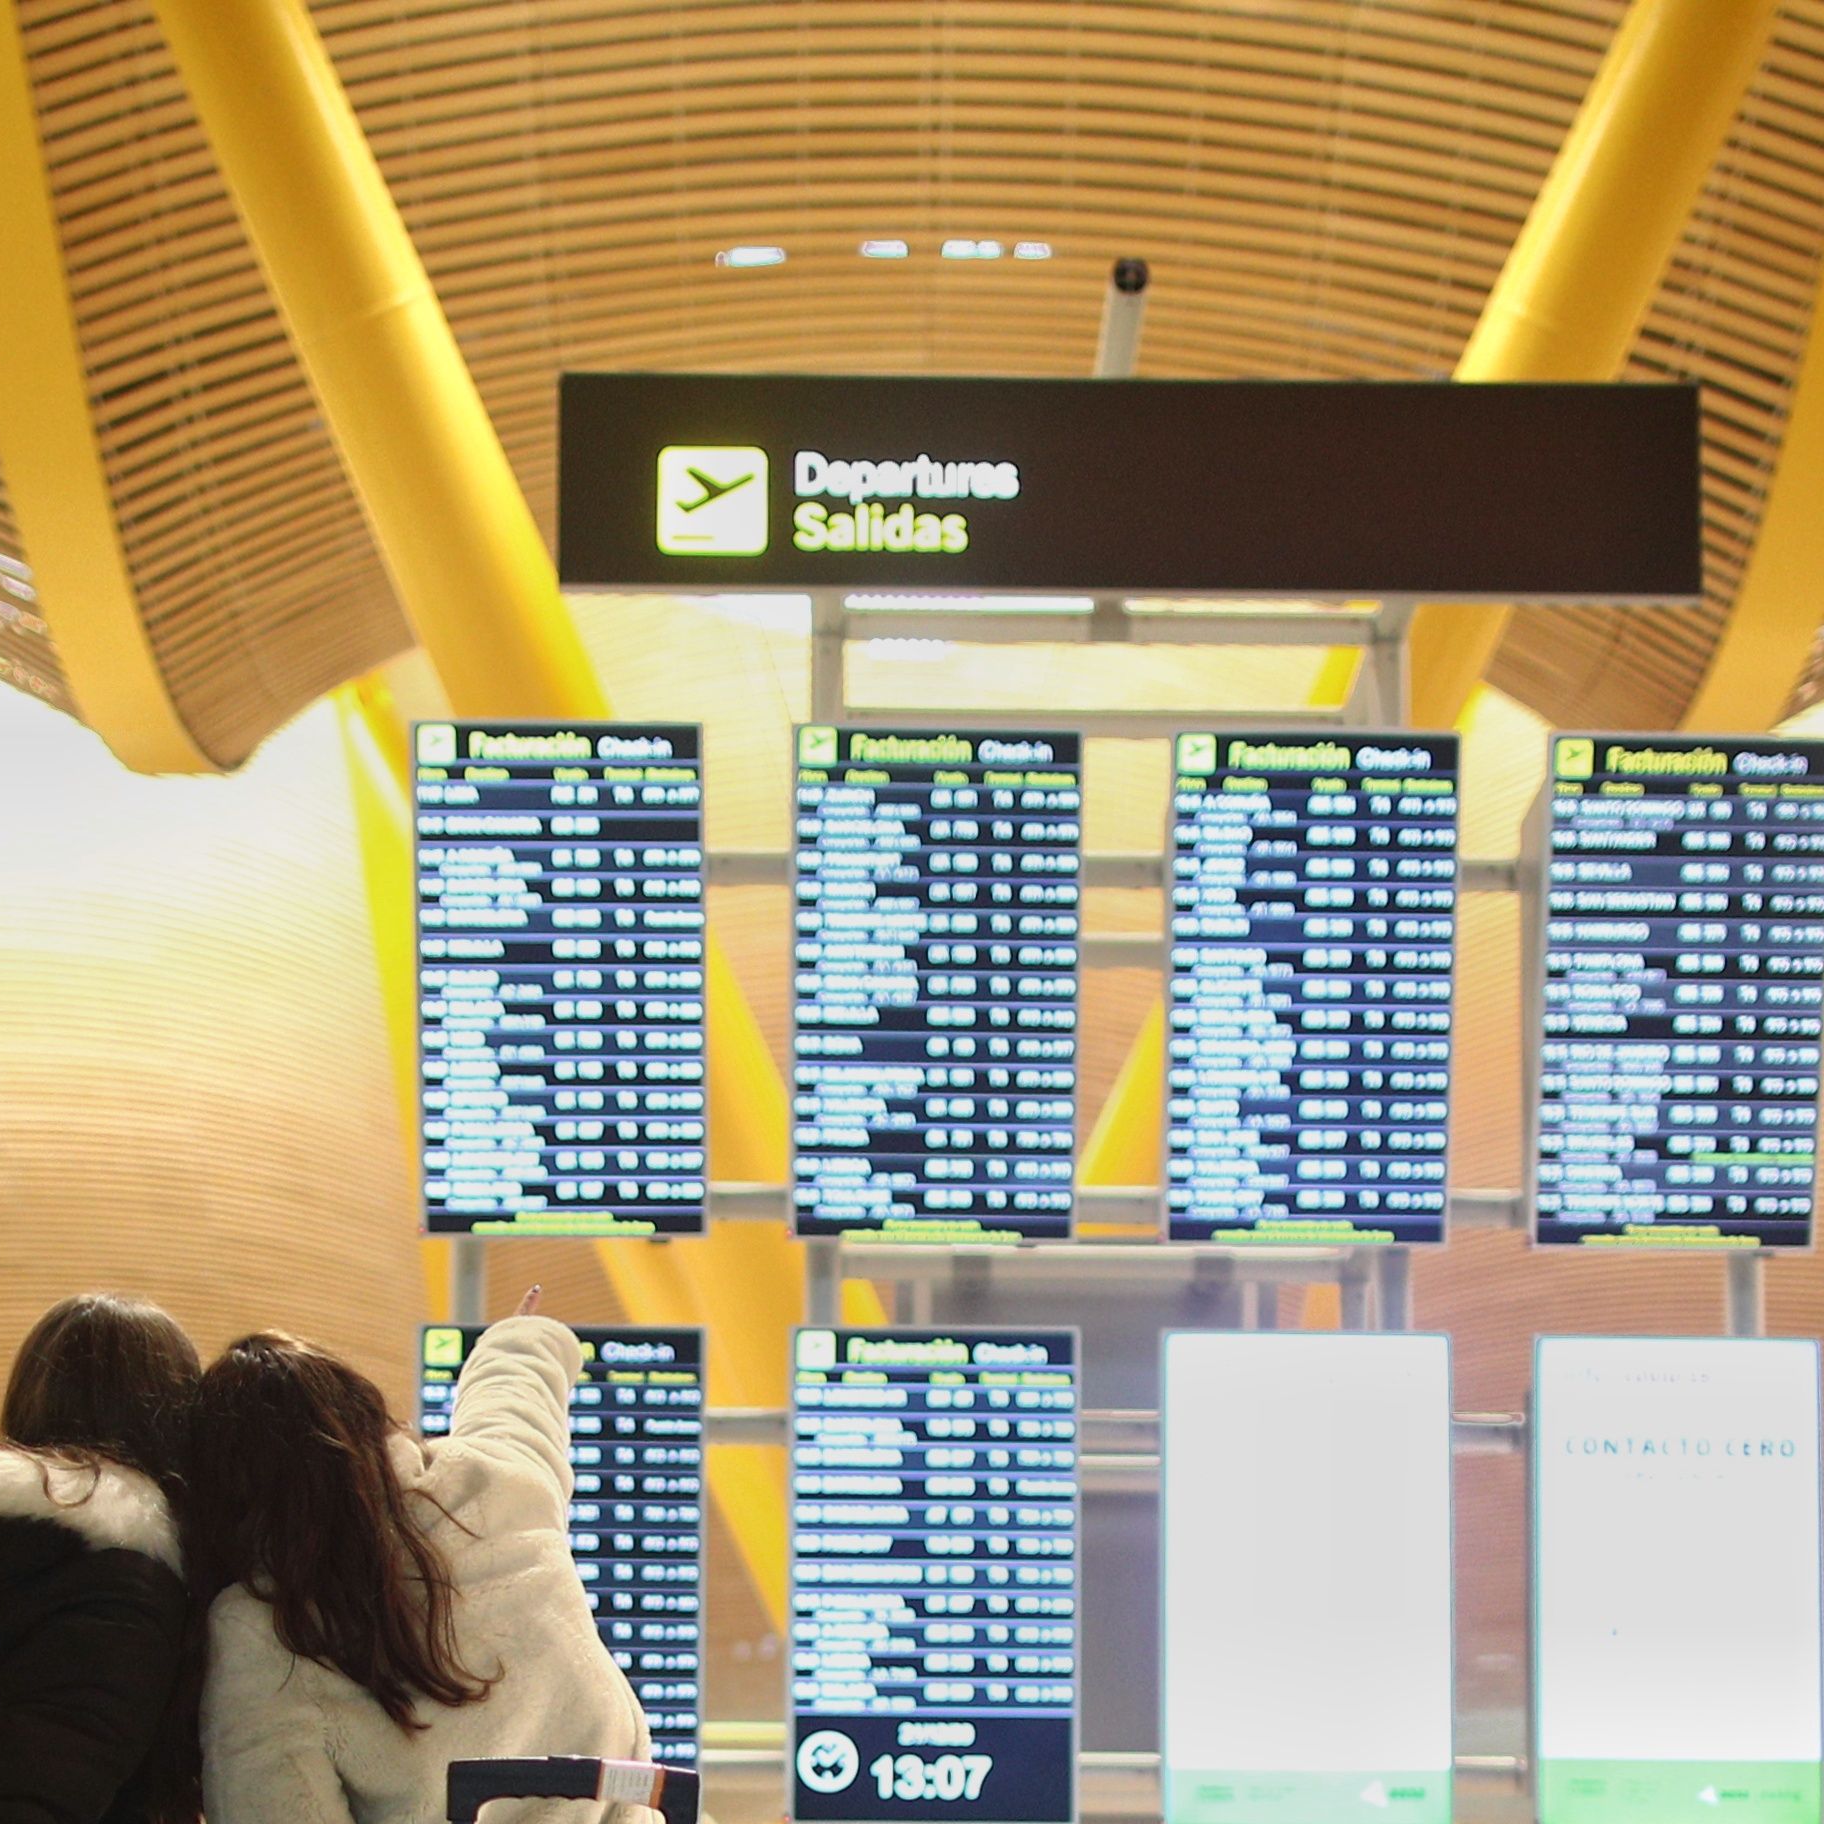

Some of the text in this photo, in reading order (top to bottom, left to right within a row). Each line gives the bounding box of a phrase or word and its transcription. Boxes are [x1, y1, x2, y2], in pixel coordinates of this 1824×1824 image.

[794, 450, 1021, 506] Departures
[792, 501, 969, 554] Salidas
[870, 1753, 993, 1801] 13:07
